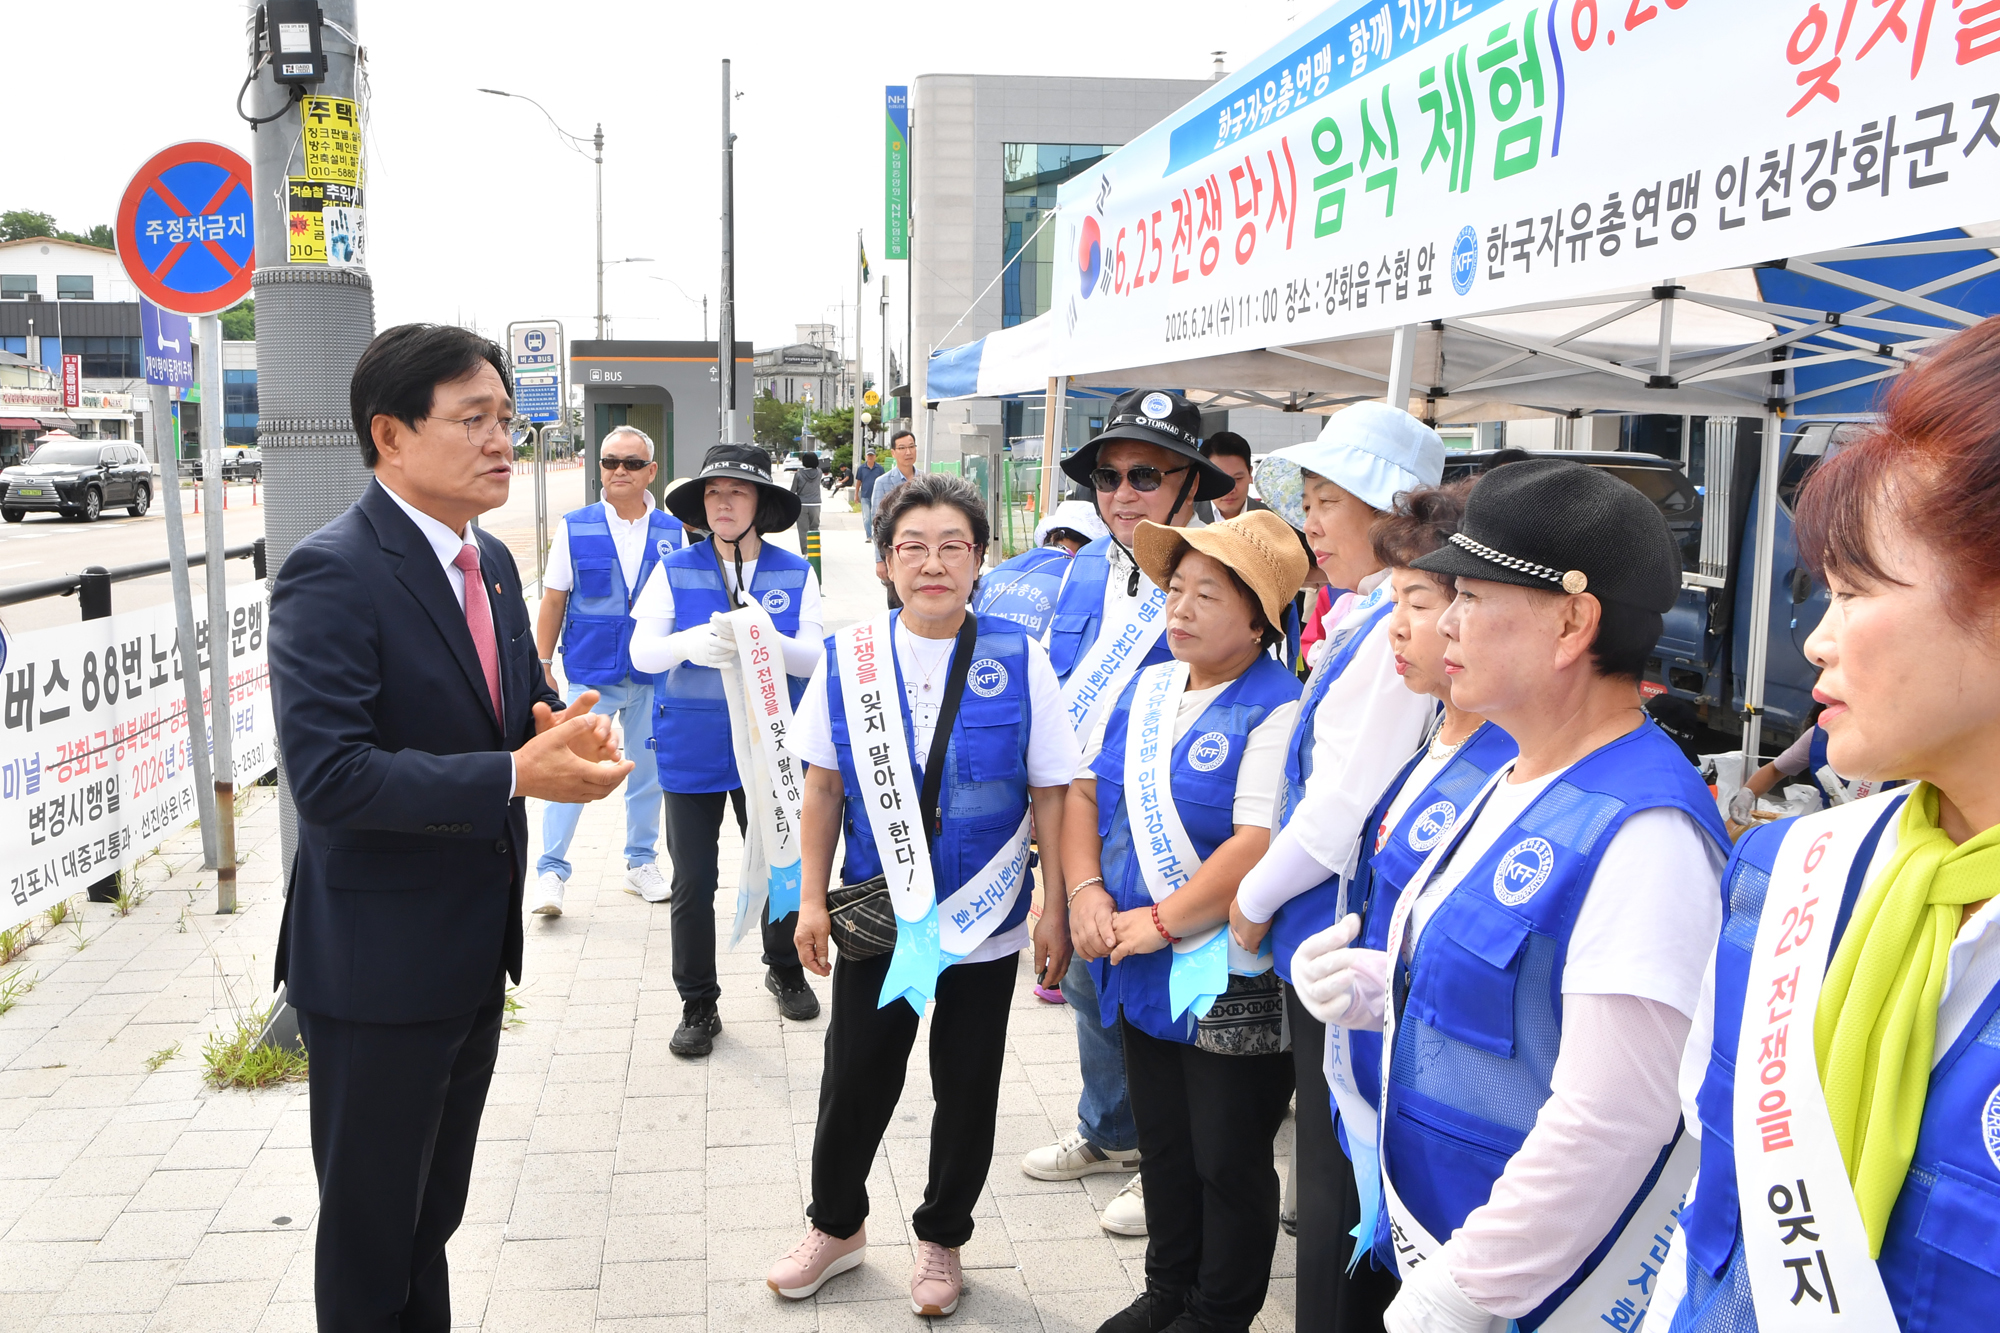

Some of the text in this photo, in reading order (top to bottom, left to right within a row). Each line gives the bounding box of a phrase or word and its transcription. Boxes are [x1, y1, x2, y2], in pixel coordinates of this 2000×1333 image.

[888, 96, 906, 104] NH
[1213, 43, 1332, 150] 한국자유총연맹
[1348, 3, 1393, 79] 함께
[290, 186, 324, 199] 겨울철
[1170, 173, 1221, 285] 전쟁
[1233, 136, 1298, 266] 당시
[1310, 83, 1401, 240] 음식
[1417, 7, 1546, 194] 체험
[146, 213, 246, 244] 주정차금지
[1455, 251, 1474, 273] KFF
[1486, 168, 1702, 281] 한국자유총연맹
[1325, 260, 1371, 316] 강화읍
[1375, 248, 1411, 301] 수협
[1417, 242, 1435, 296] 앞
[66, 364, 76, 405] 동물병원
[604, 371, 622, 382] BUS
[769, 598, 784, 606] KFF
[5, 601, 262, 732] 버스 88번 노선변운행
[976, 672, 999, 685] KFF
[1068, 623, 1144, 732] 인천강화군지
[2, 752, 41, 800] 미널
[112, 706, 161, 762] 행복센터
[756, 666, 780, 717] 전쟁을
[777, 755, 801, 802] 말아야
[852, 624, 916, 893] 전쟁을 잊지 말아야 한다!
[1196, 746, 1220, 758] KFF
[29, 774, 120, 846] 변경시행일
[132, 743, 175, 800] 2026년
[1138, 768, 1190, 891] 인천강화군지
[1420, 816, 1442, 836] KFF
[10, 858, 60, 907] 김포시
[61, 824, 131, 878] 대중교통과
[141, 784, 196, 840] 선진상운(주)
[951, 836, 1031, 934] 천강화군지회
[1505, 859, 1538, 884] KFF
[1754, 831, 1841, 1315] 6.25 전쟁을 잊지
